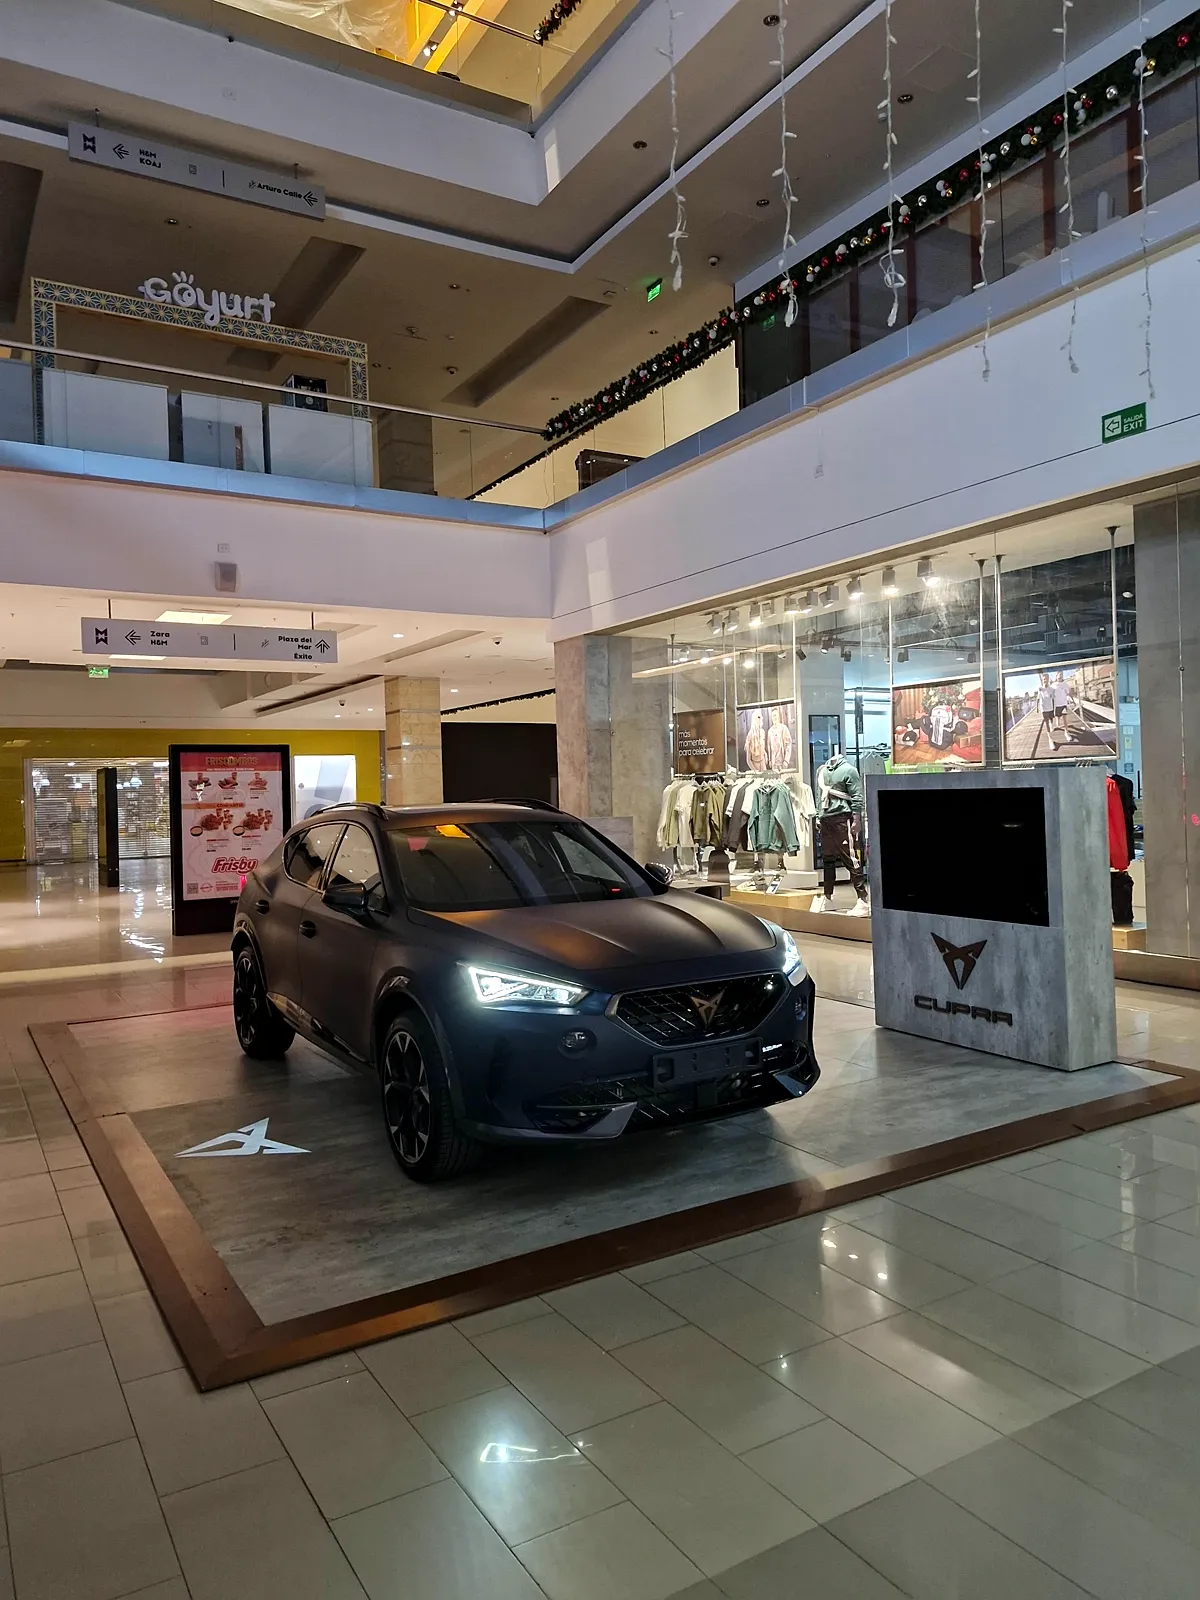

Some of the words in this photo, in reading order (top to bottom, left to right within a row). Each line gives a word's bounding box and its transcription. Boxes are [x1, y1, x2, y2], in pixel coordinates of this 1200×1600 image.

[139, 149, 157, 159] H&M
[139, 157, 161, 168] KOAJ
[257, 182, 282, 194] Arturo
[283, 189, 302, 199] Calle
[1123, 413, 1144, 424] SALIDA
[1123, 419, 1144, 432] EXIT
[150, 630, 170, 638] Zara
[278, 635, 299, 643] Plaza
[293, 652, 313, 660] Éxito
[679, 738, 708, 747] momentos
[679, 748, 692, 756] para
[692, 747, 714, 755] celebrar
[212, 856, 258, 874] Frisby
[914, 995, 1013, 1027] CUPRA
